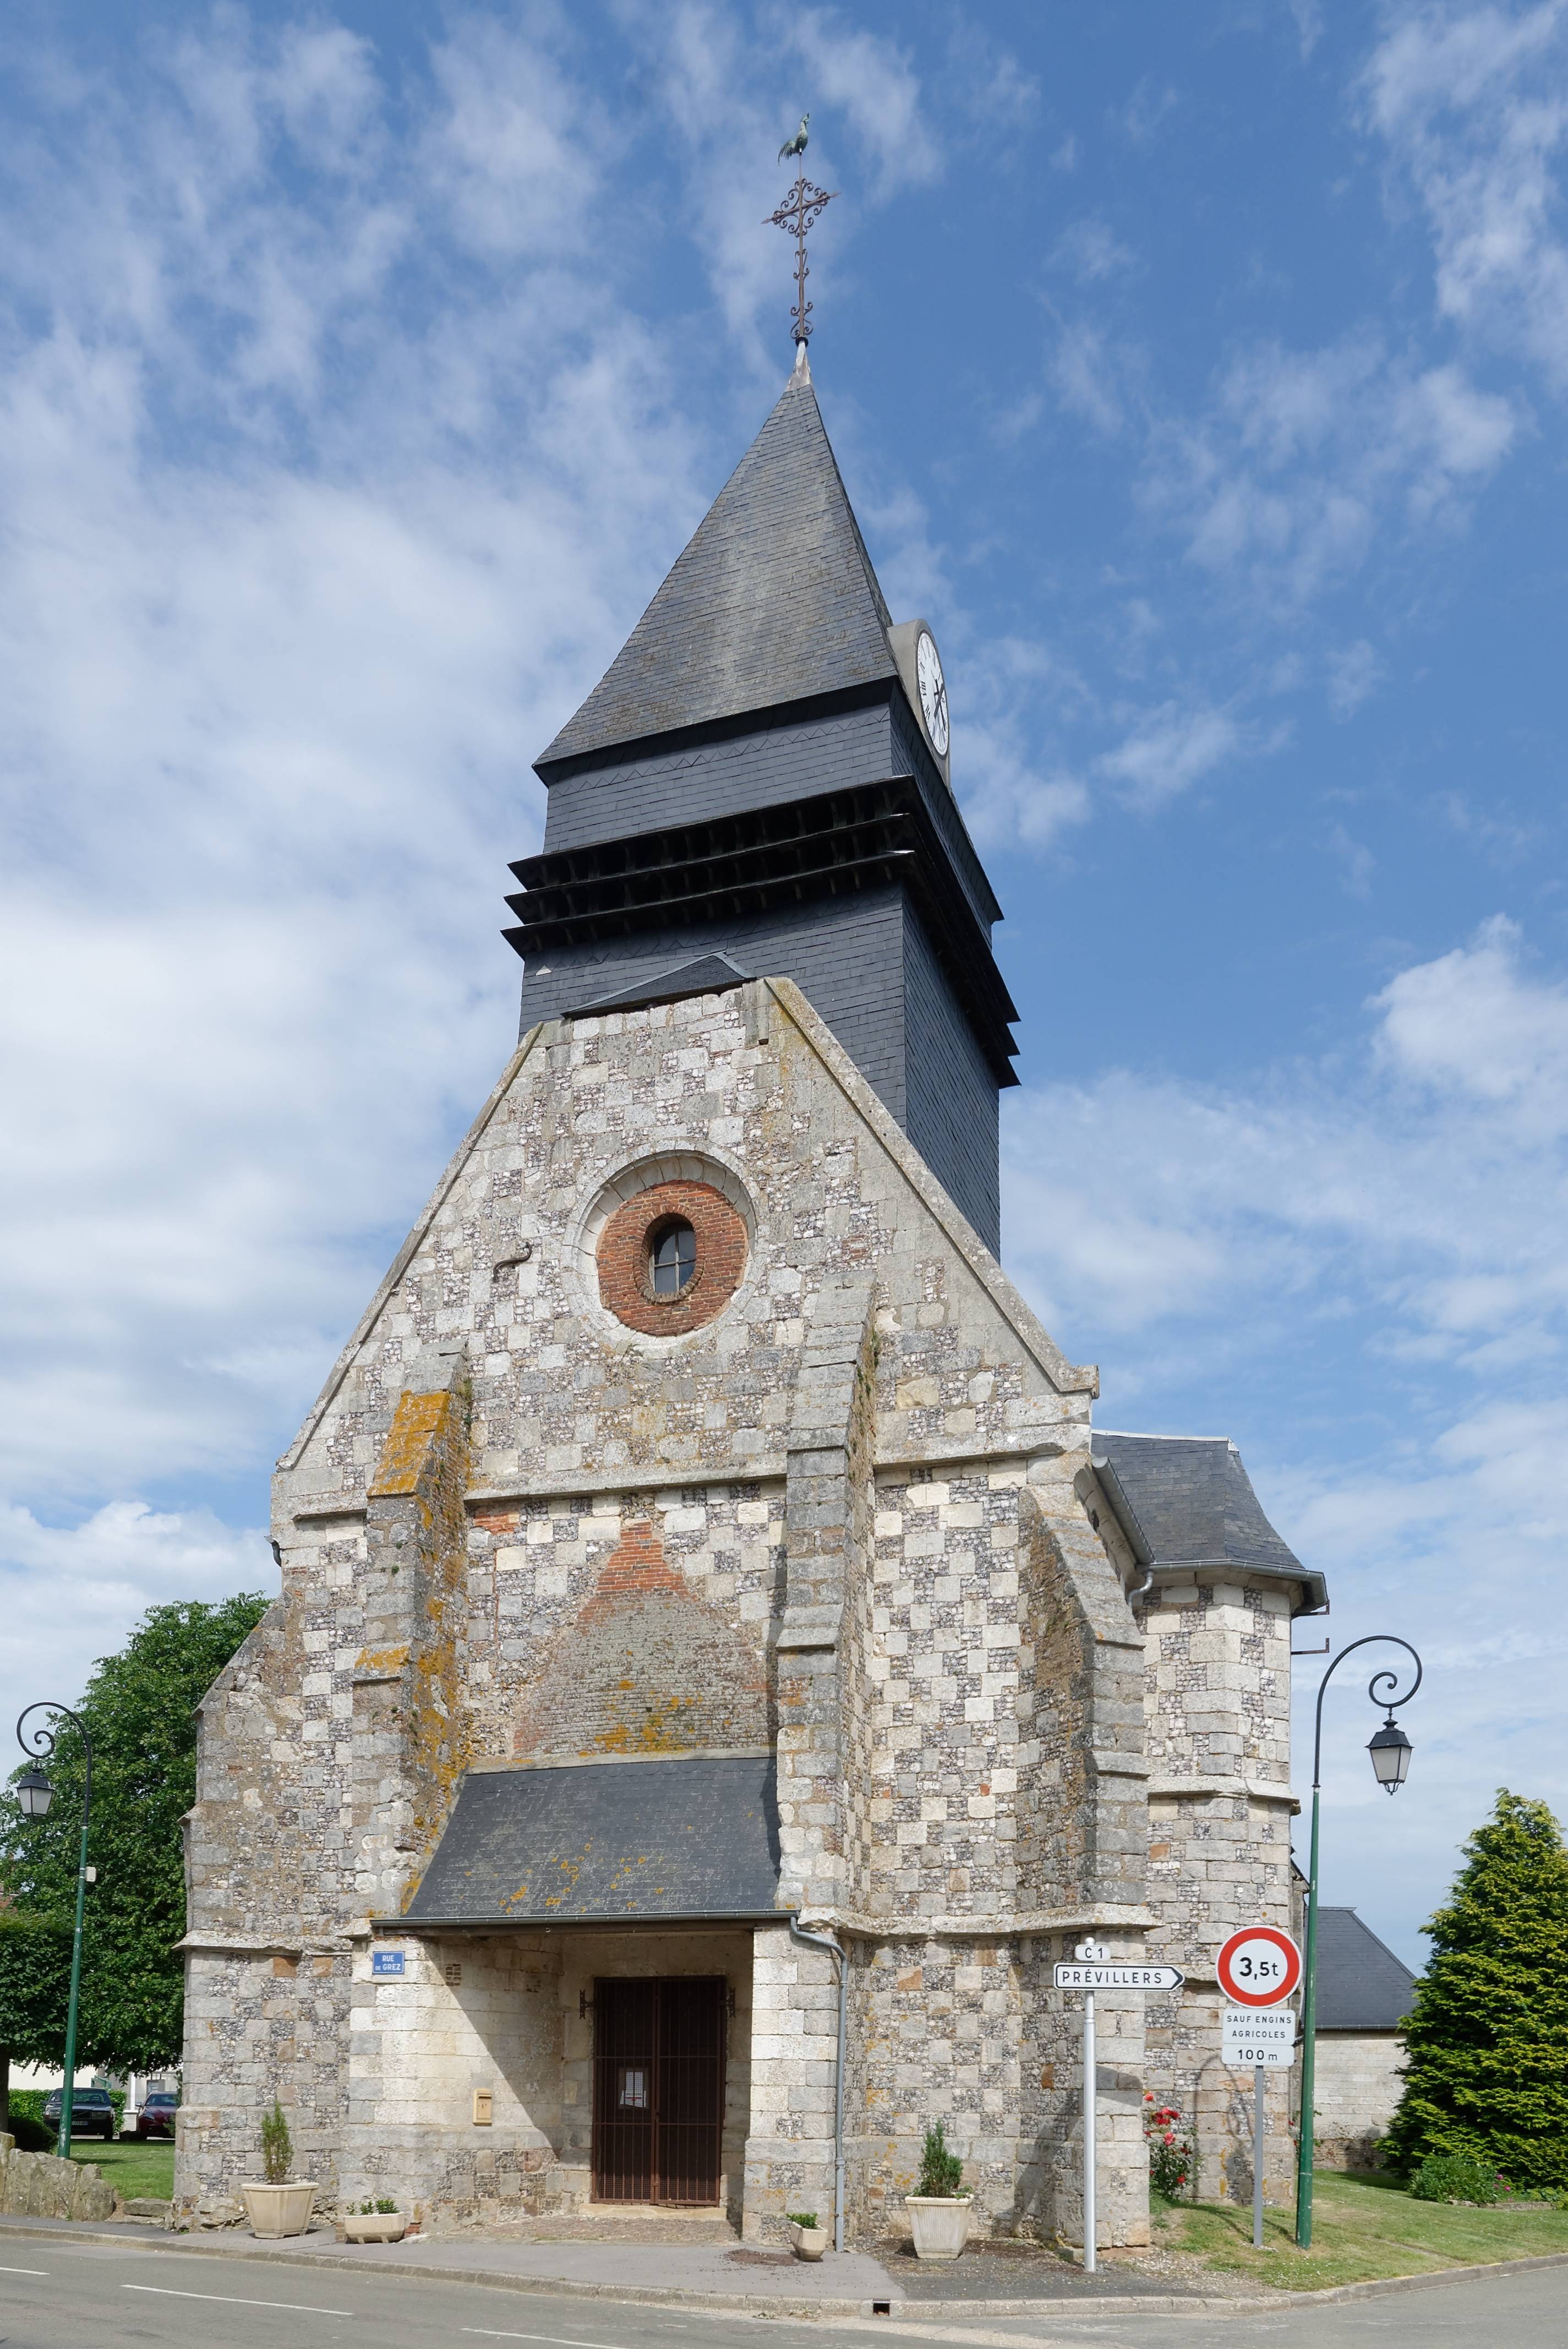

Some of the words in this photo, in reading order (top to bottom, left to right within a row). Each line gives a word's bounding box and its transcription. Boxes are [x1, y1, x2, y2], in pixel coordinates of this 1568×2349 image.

[1085, 1947, 1092, 1958] C
[1098, 1947, 1103, 1959] 1
[1063, 1969, 1161, 1984] PRÉVILLERS
[1232, 2030, 1285, 2038] AGRICOLES
[1238, 2049, 1264, 2060] 100
